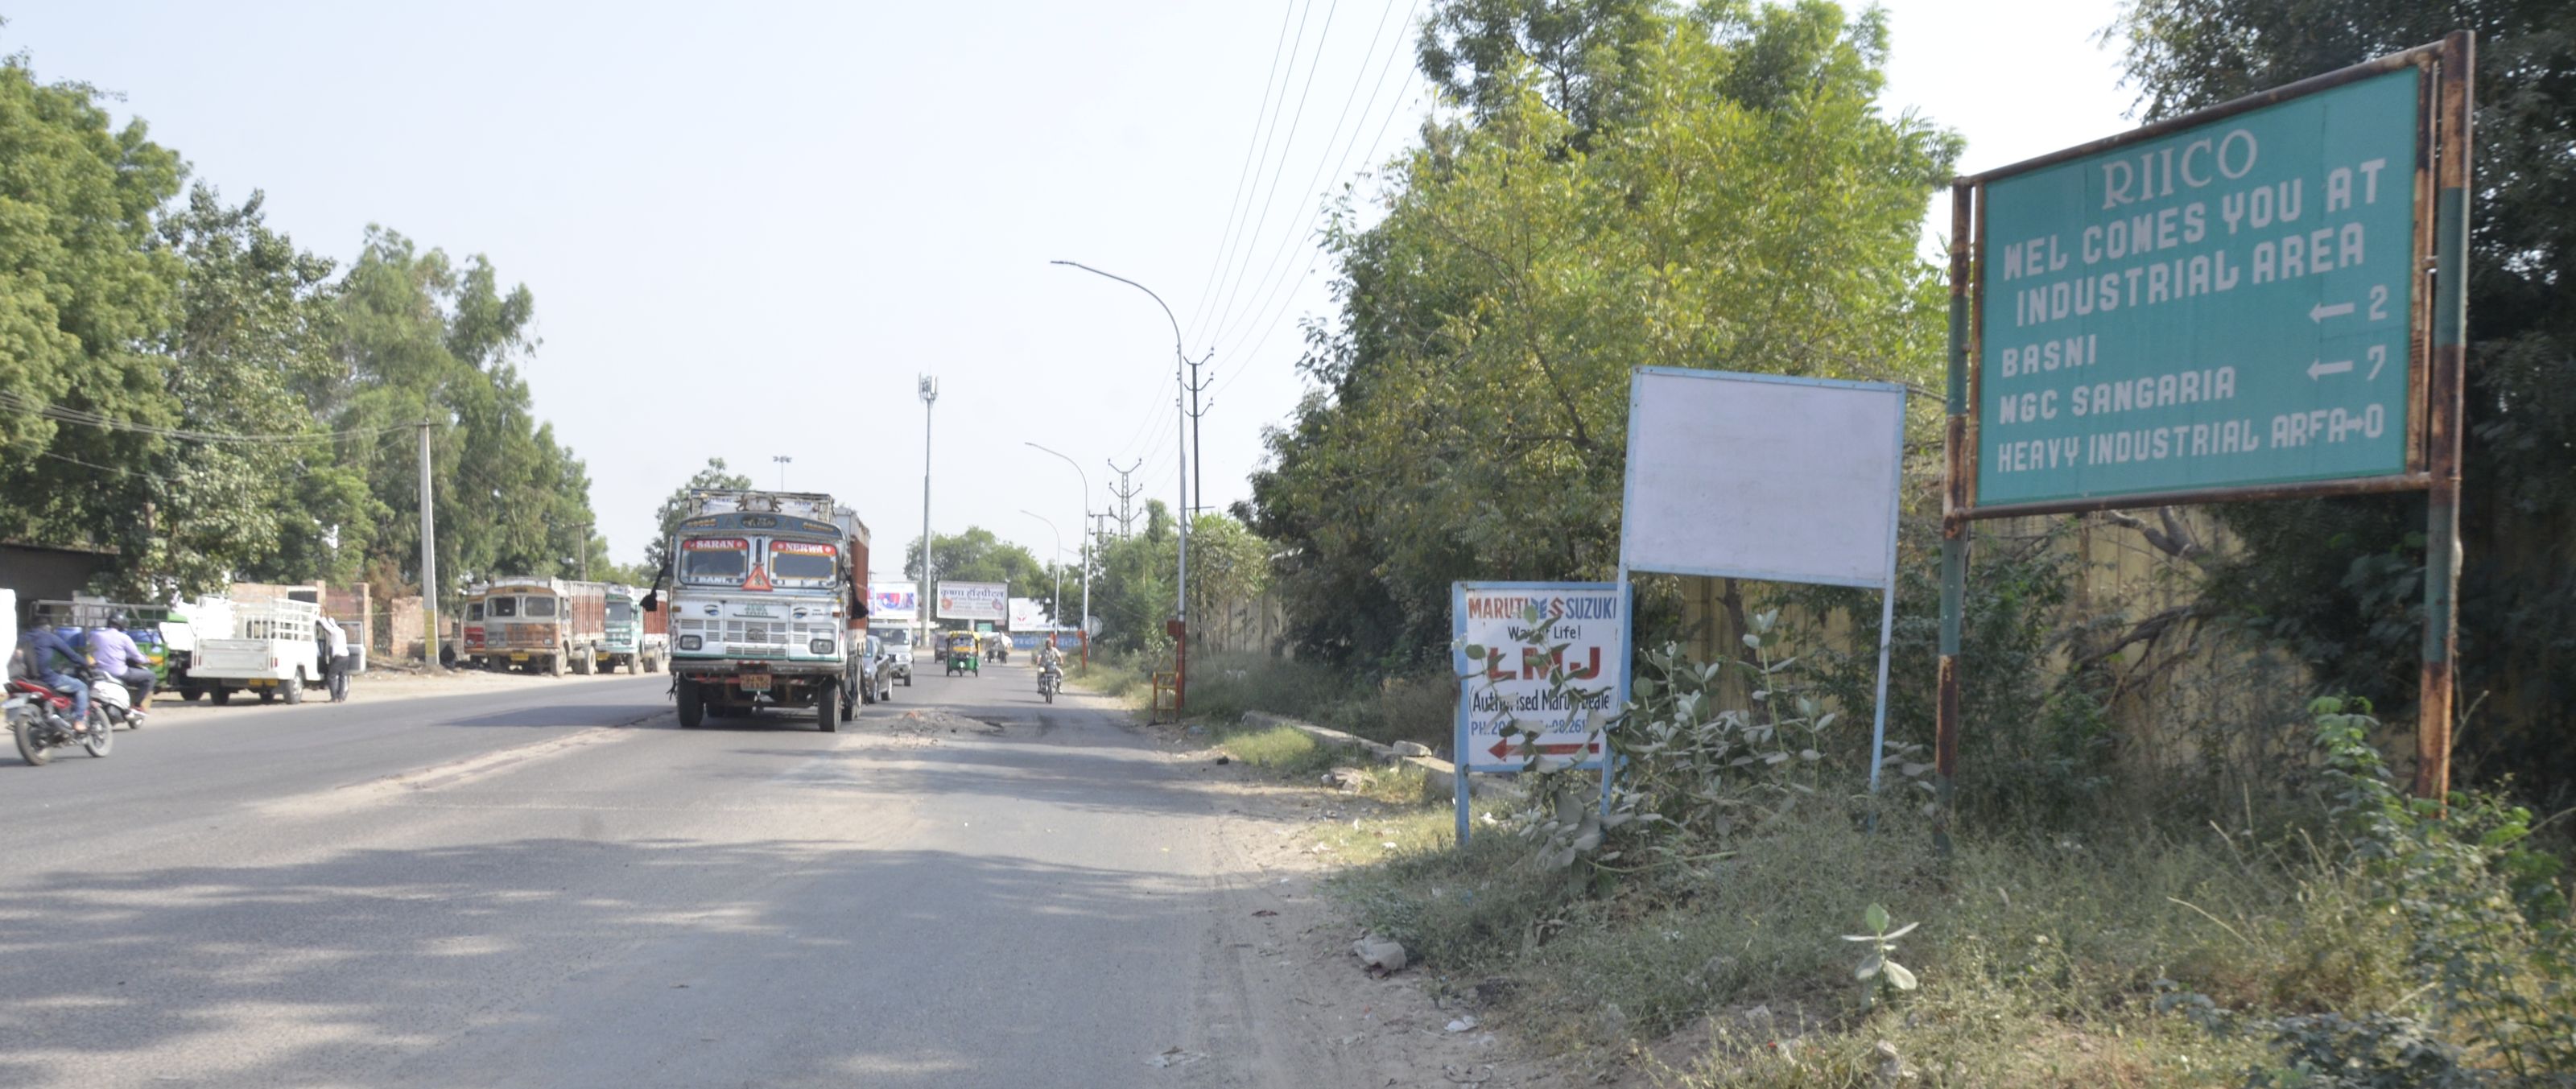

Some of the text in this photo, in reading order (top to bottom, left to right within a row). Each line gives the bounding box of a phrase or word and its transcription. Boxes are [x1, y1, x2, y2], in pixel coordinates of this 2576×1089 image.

[2102, 130, 2256, 209] RIICO
[2004, 159, 2386, 281] WEL COMES YOU AT
[2017, 222, 2363, 327] INDUSTRIAL AREA
[2369, 284, 2388, 321] 2
[2002, 334, 2096, 377] BASNI
[2368, 344, 2386, 381] 7
[1999, 366, 2235, 425] MGC SANGARIA
[1998, 436, 2079, 473] HEAVY
[2088, 419, 2259, 465] INDUSTRIAL
[1566, 596, 1617, 620] SUZUKI
[1554, 625, 1581, 640] Life!
[1542, 688, 1575, 711] Maru
